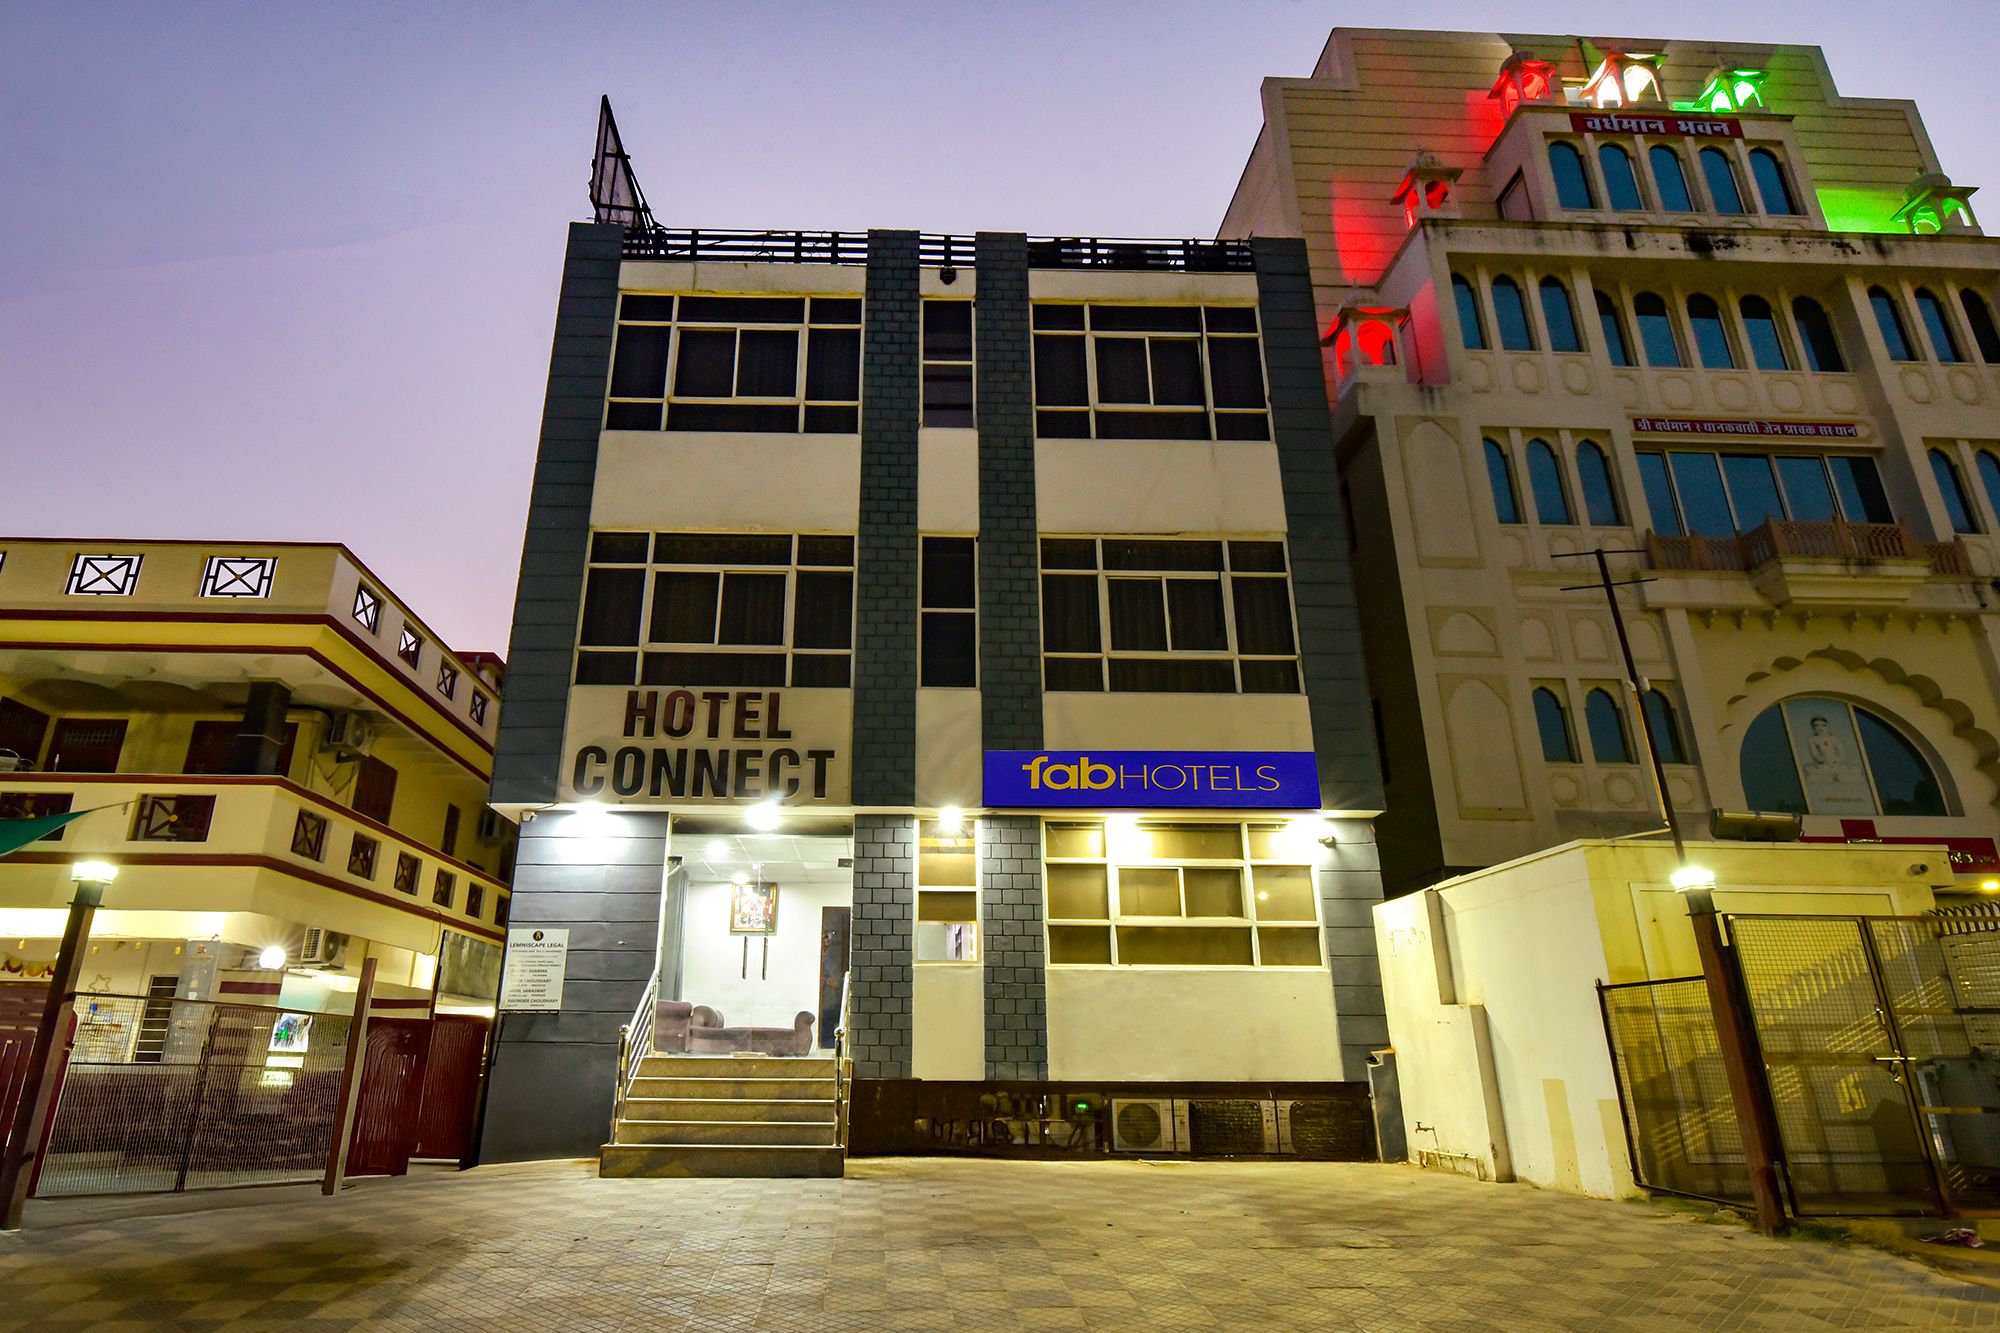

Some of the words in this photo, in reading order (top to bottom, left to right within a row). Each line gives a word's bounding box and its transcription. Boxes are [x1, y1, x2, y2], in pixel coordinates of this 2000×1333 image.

[1583, 112, 1666, 133] वर्धमान
[1676, 120, 1730, 136] भवन
[1637, 418, 1652, 432] श्री
[622, 689, 793, 741] HOTEL
[572, 745, 836, 799] CONNECT
